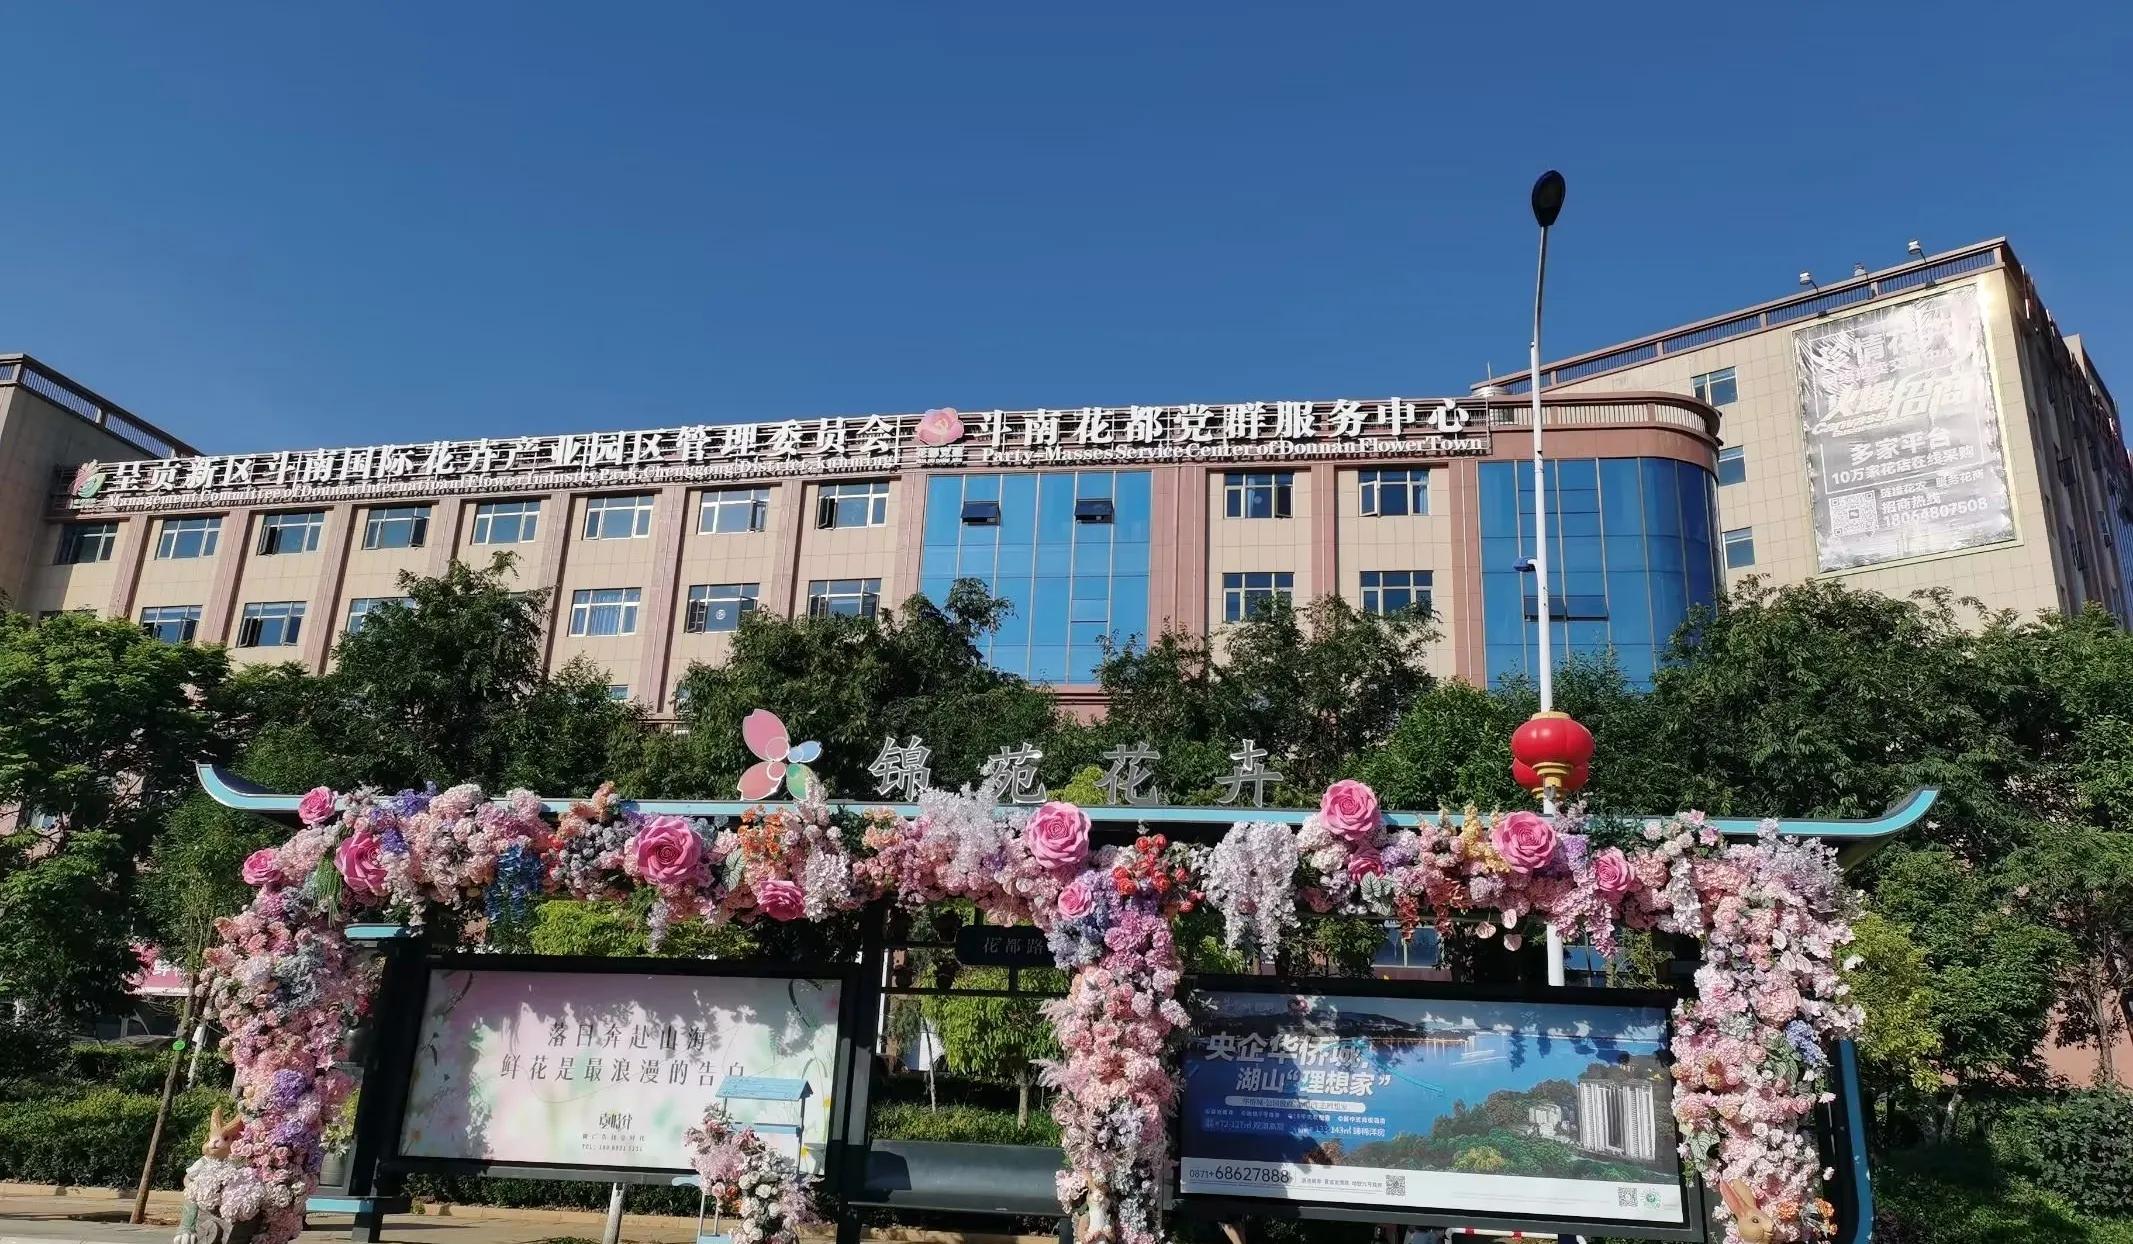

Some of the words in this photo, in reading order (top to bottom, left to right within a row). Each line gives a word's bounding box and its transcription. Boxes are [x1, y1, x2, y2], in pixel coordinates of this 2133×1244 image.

[976, 397, 1470, 446] 斗南花都党群服务中心
[109, 414, 895, 491] 呈贡新区斗南国际花卉产业园区管理委员会
[1115, 441, 1185, 460] Service
[1187, 442, 1253, 458] Center
[1256, 440, 1277, 455] of
[1279, 440, 1357, 455] Dounan
[1359, 436, 1421, 452] Flower
[1425, 435, 1482, 450] Town
[1832, 445, 1974, 485] 10万家花店在线采购
[1850, 427, 1950, 466] 多家平台
[107, 490, 196, 509] Management
[200, 484, 285, 500] Committee
[285, 484, 301, 498] of
[301, 481, 363, 497] Dounan
[468, 472, 526, 487] Flower
[527, 468, 595, 483] Industry
[1882, 493, 1941, 514] 招商热线
[868, 735, 1284, 807] 锦苑花卉
[984, 937, 1044, 954] 花都路
[548, 1022, 706, 1050] 落日奔赴山海
